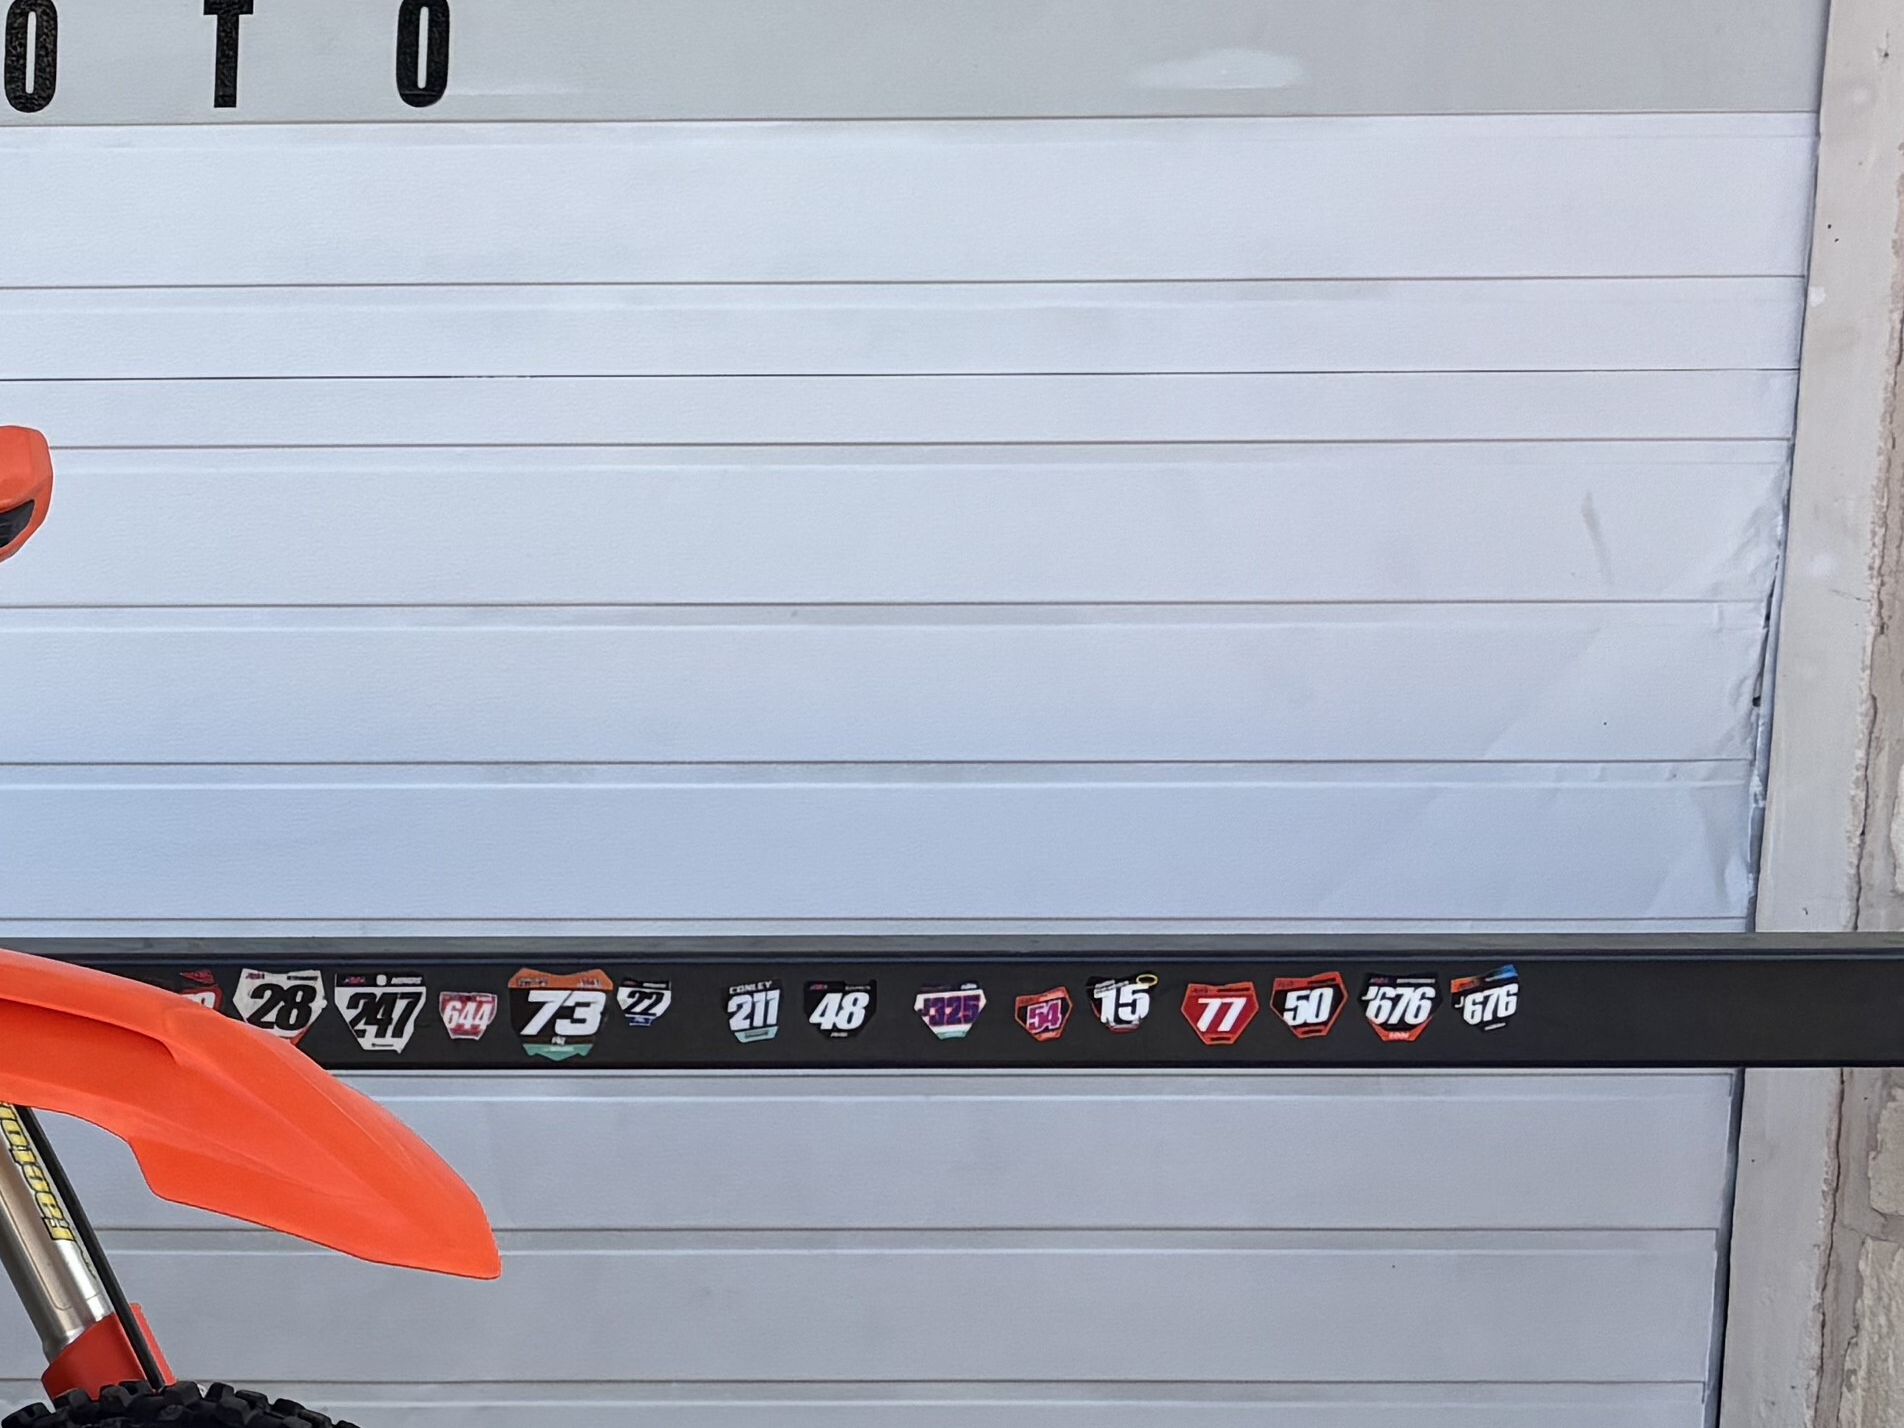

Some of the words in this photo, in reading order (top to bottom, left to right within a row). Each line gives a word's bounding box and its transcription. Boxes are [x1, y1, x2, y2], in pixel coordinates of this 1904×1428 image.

[245, 983, 318, 1031] 28
[622, 990, 665, 1017] 22
[728, 980, 773, 995] CONLEY
[1094, 983, 1151, 1023] 15
[1283, 987, 1334, 1027] 50
[345, 992, 423, 1039] 247
[443, 1000, 491, 1030] 644
[519, 989, 607, 1036] 73
[727, 989, 781, 1031] 211
[808, 991, 870, 1031] 48
[1025, 999, 1063, 1033] 54
[1196, 997, 1247, 1033] 77
